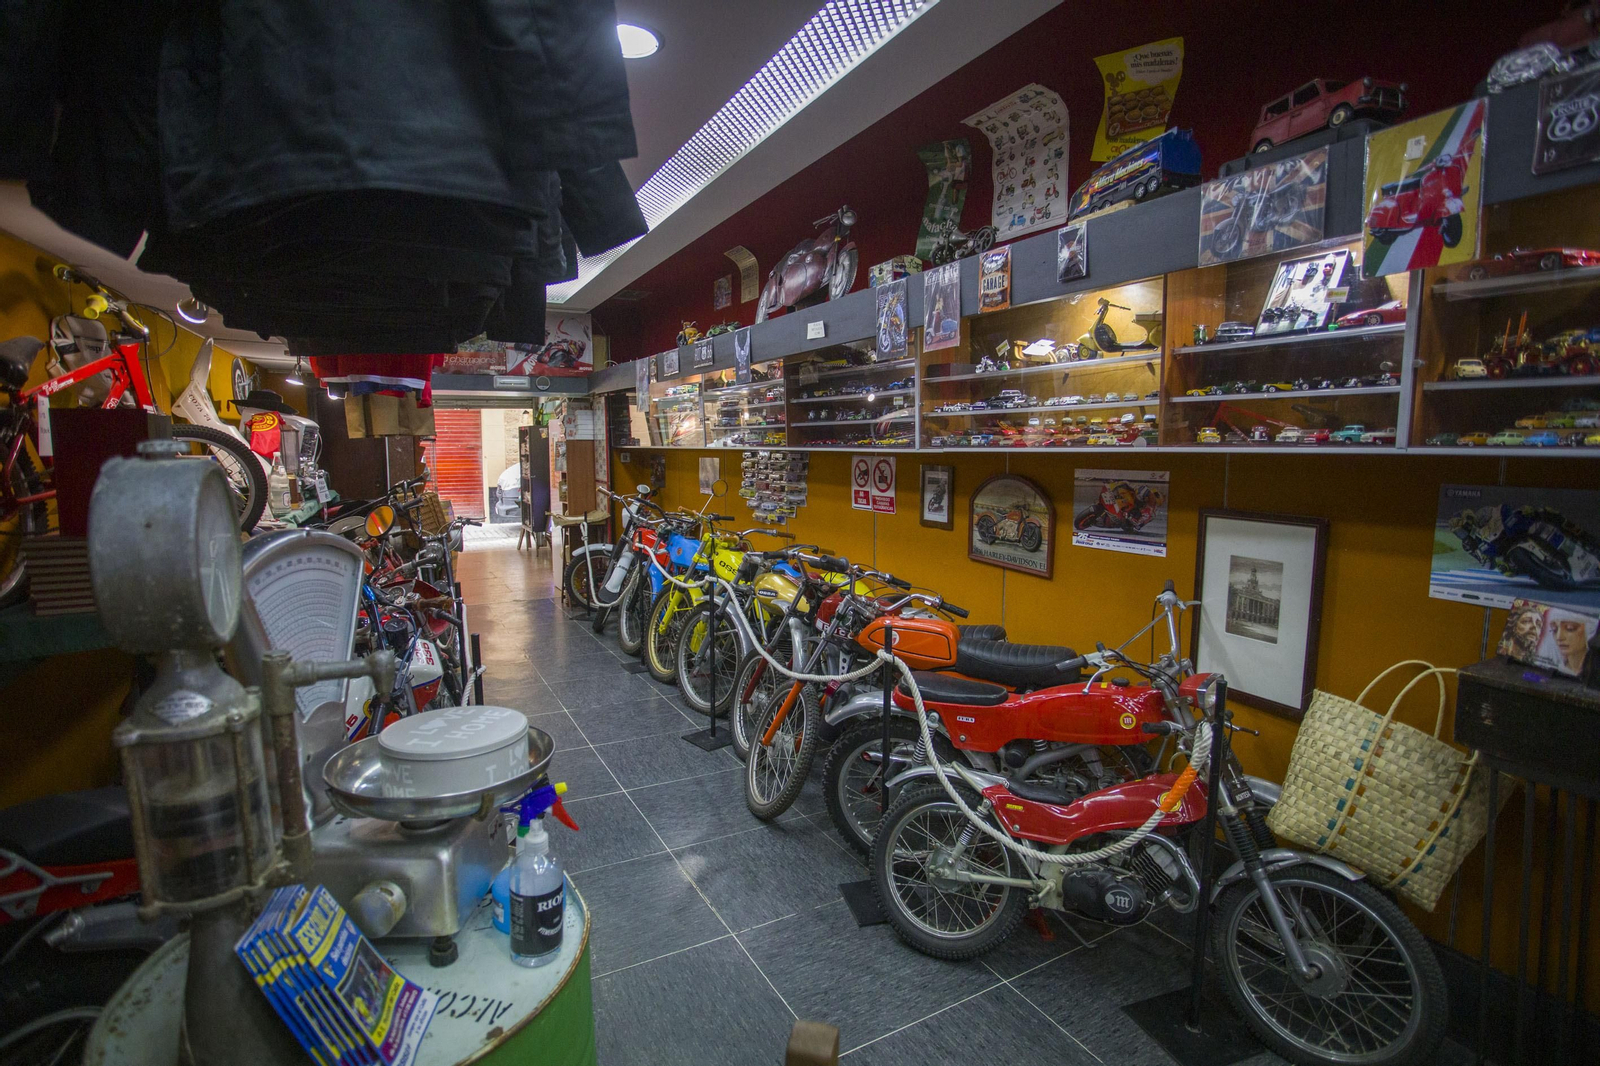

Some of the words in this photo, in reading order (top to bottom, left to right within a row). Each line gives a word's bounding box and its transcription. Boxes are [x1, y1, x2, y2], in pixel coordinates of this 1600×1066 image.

[1554, 110, 1590, 137] 66
[982, 274, 1005, 292] GARAGE
[449, 354, 496, 366] champions
[444, 709, 512, 740] HOME
